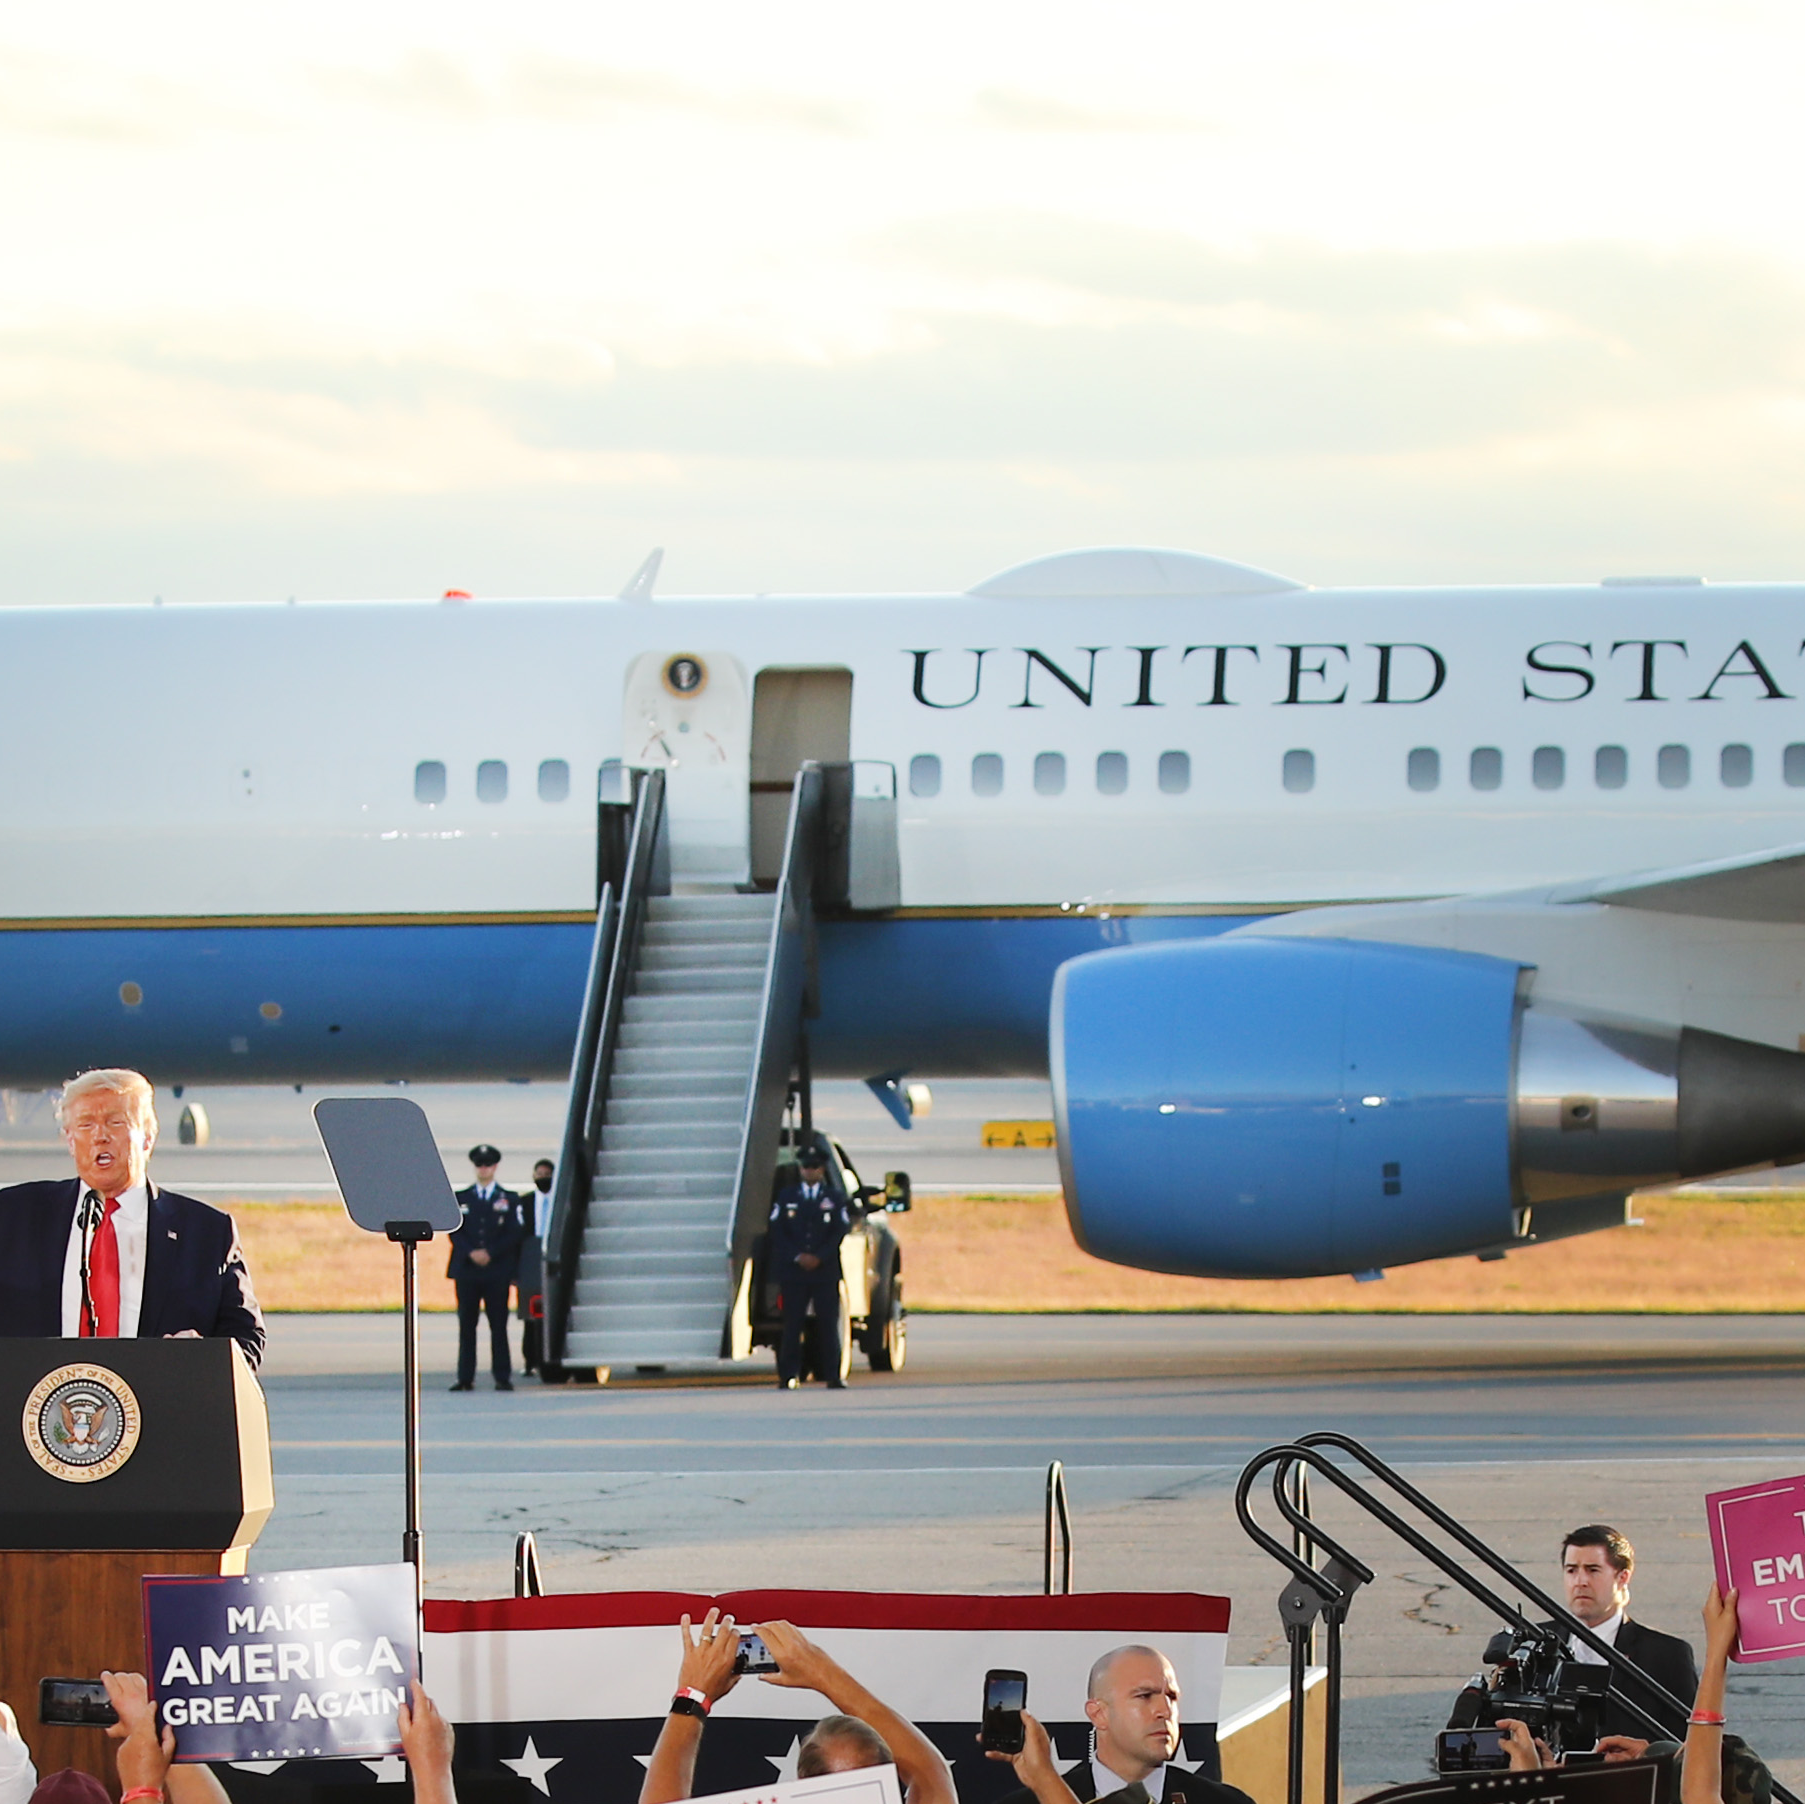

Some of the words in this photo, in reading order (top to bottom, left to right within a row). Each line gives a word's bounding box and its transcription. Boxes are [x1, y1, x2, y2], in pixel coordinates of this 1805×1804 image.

[910, 645, 1446, 712] UNITED
[29, 1369, 84, 1416] PRESIDENT
[116, 1384, 137, 1434] UNITED
[88, 1445, 129, 1477] STATES
[226, 1601, 331, 1637] MAKE
[161, 1635, 405, 1689] AMERICA
[162, 1694, 283, 1728] GREAT
[291, 1686, 406, 1723] AGAIN
